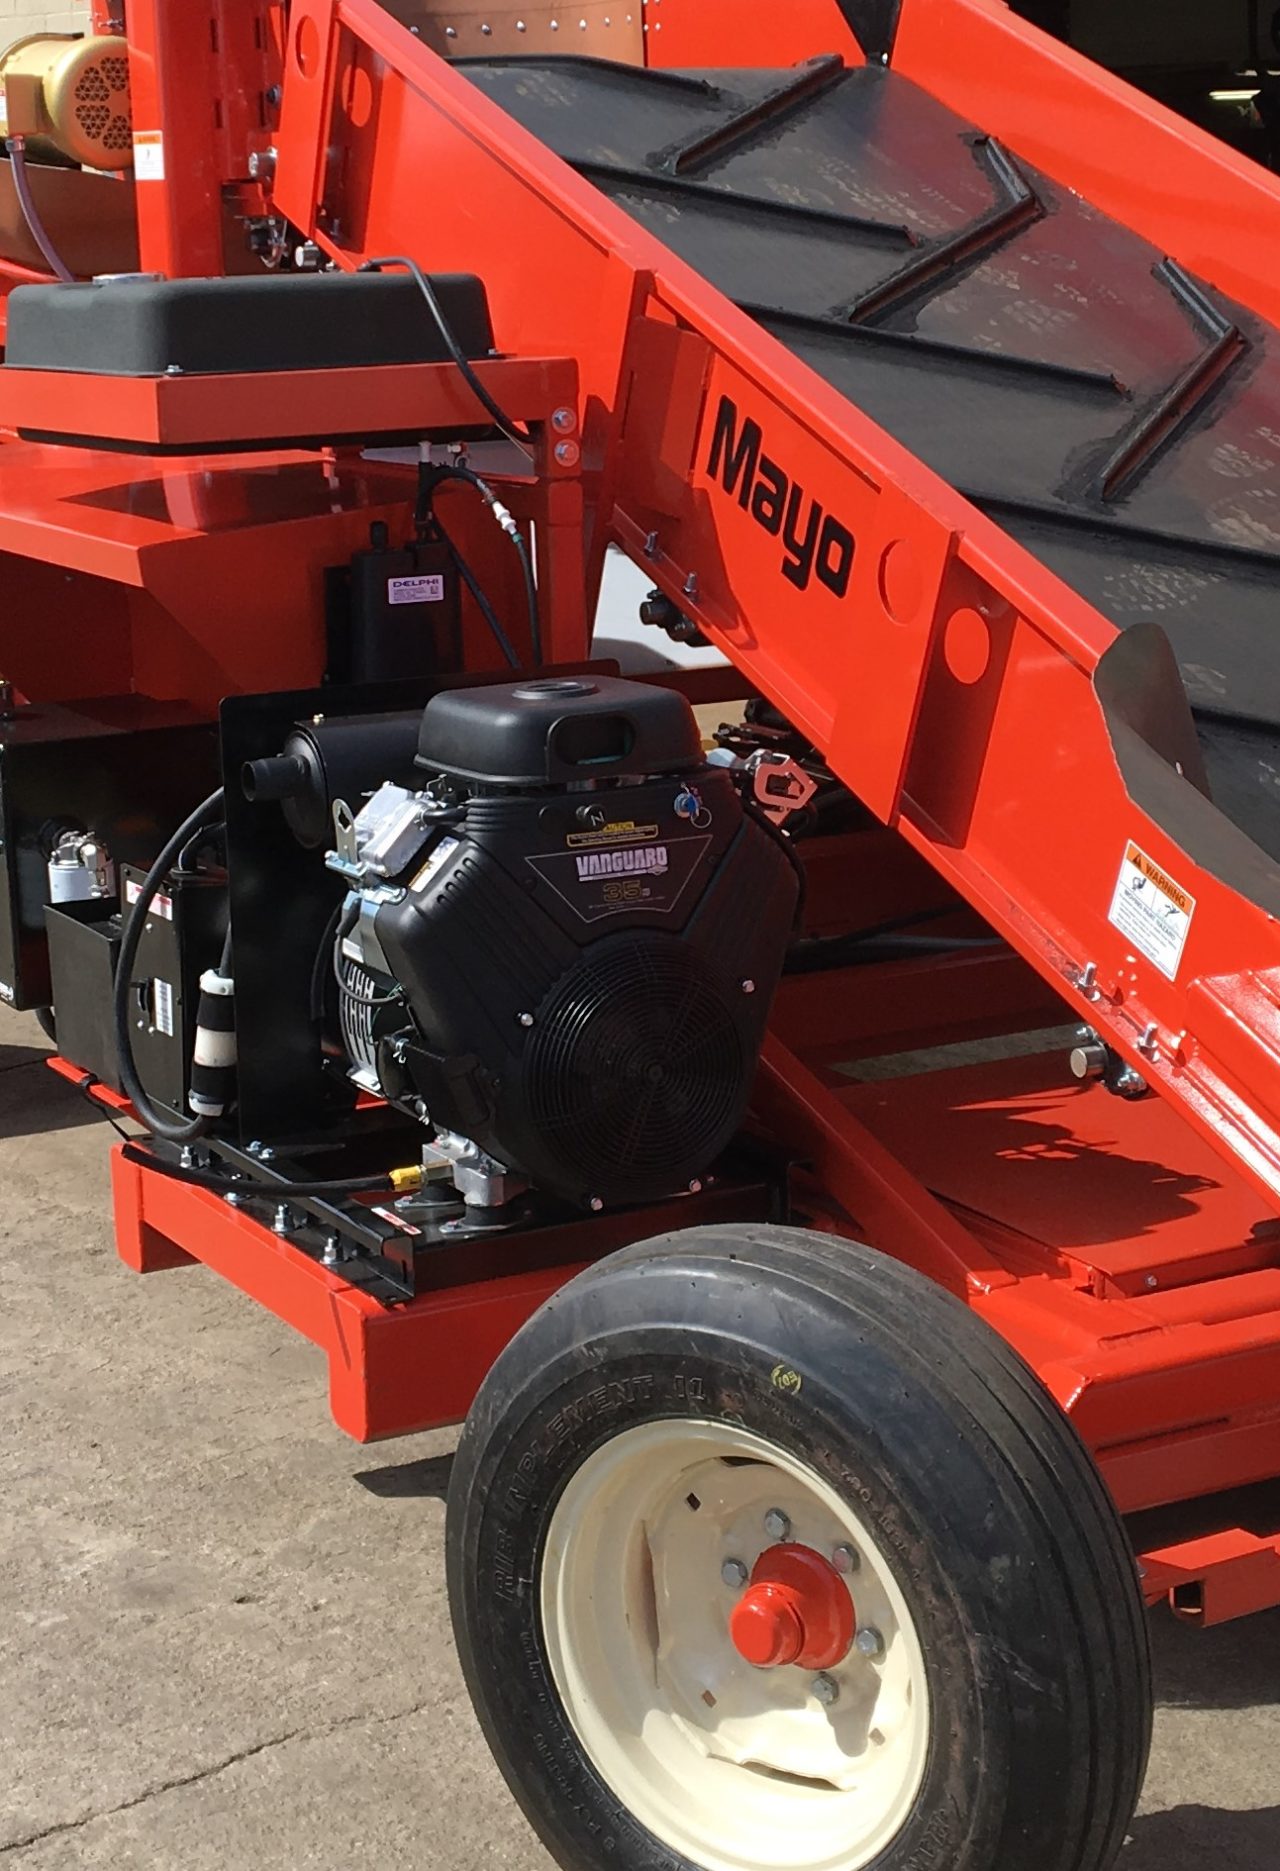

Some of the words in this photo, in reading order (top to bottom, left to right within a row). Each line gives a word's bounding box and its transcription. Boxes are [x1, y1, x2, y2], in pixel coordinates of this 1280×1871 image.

[706, 394, 855, 599] Mayo
[393, 579, 439, 588] DELPHI
[576, 847, 668, 876] VANGUARD
[603, 880, 641, 902] 35
[1145, 862, 1187, 908] WARNING
[1156, 917, 1176, 941] HAZARD
